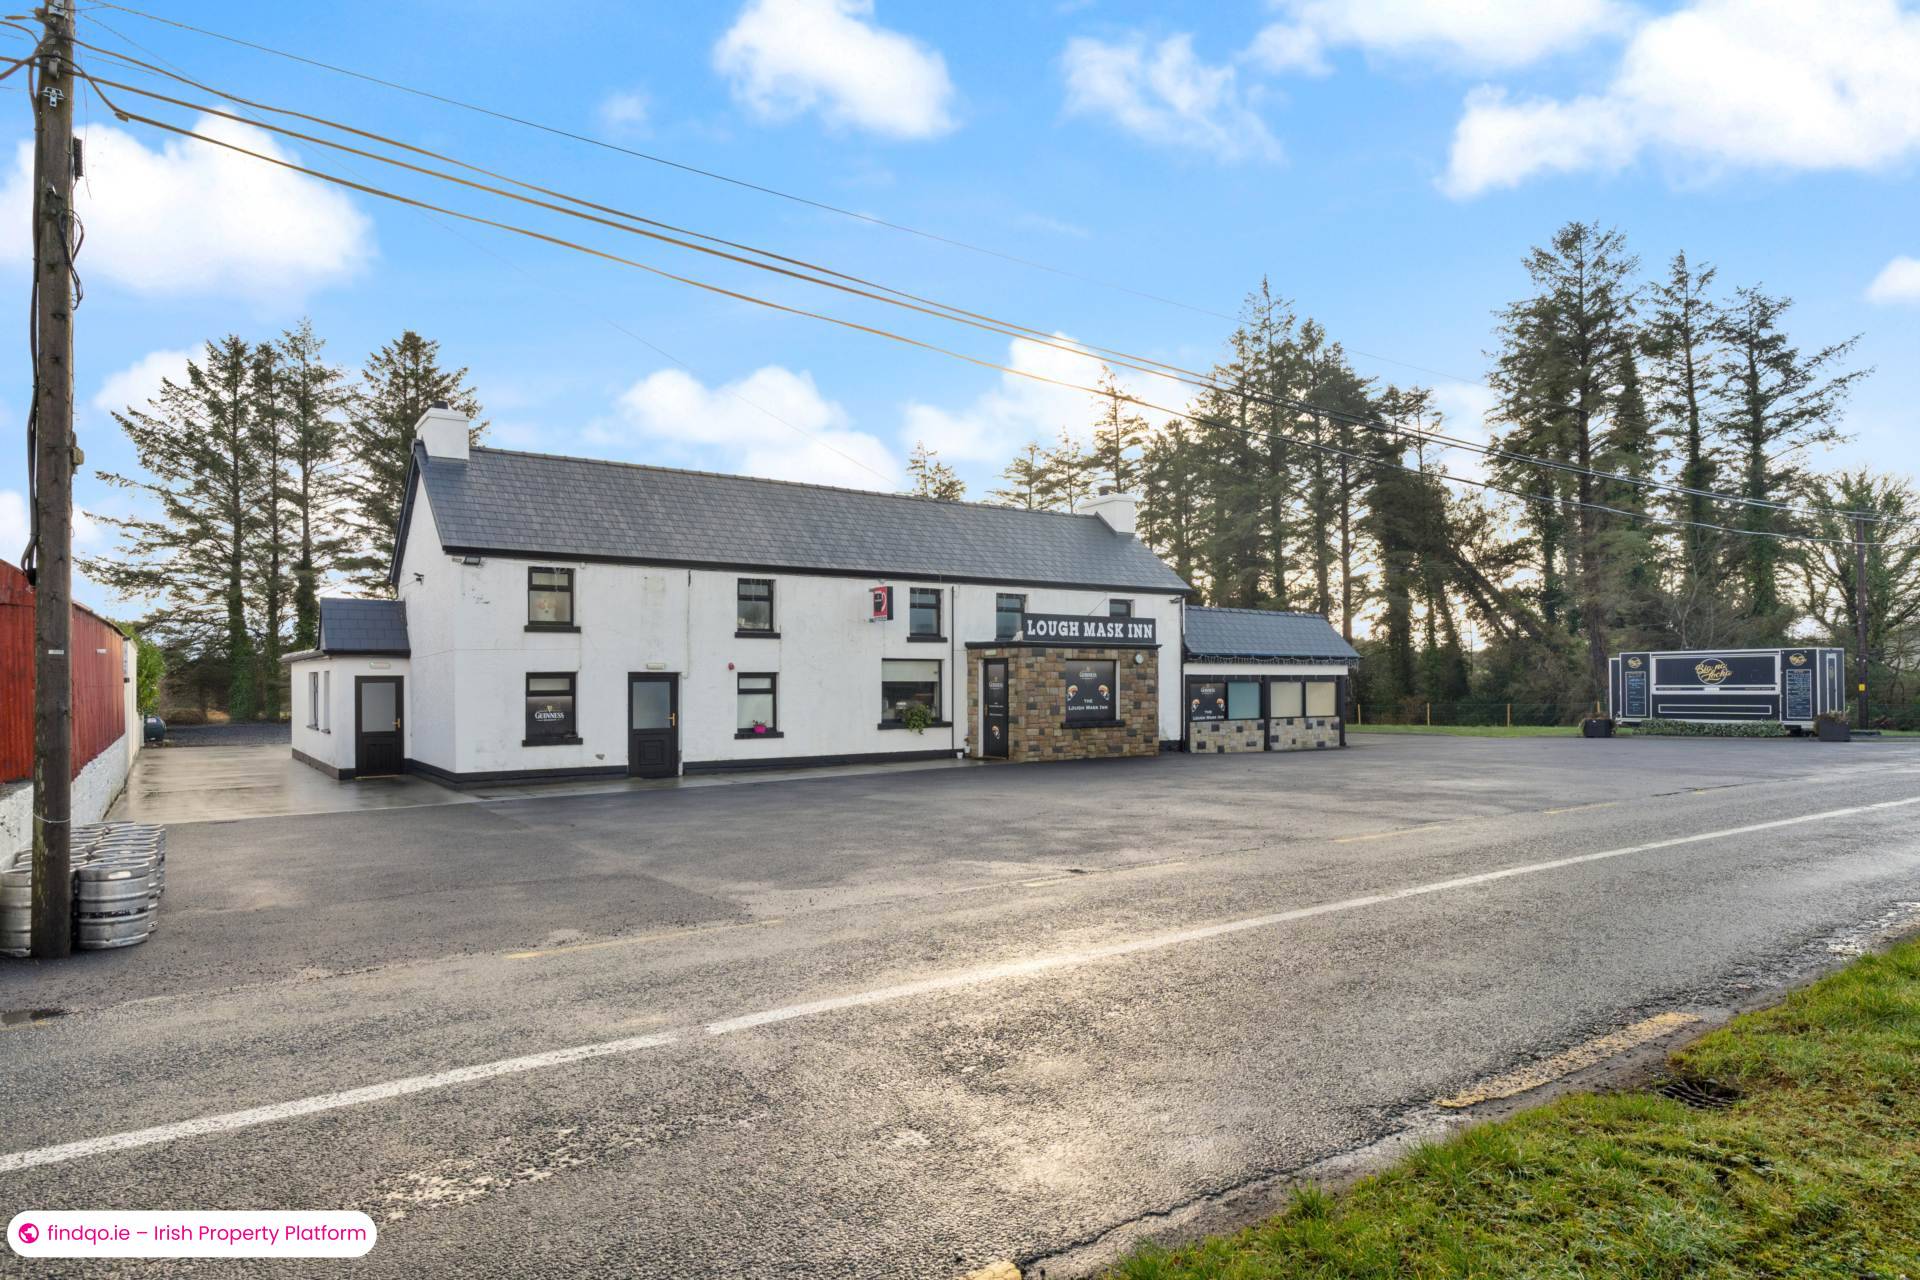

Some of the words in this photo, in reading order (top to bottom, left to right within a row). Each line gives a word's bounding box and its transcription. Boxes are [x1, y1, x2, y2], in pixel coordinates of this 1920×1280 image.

[1027, 620, 1080, 637] LOUGH
[1083, 622, 1124, 638] MASK
[1127, 623, 1153, 639] INN
[534, 711, 565, 719] GUINNESS
